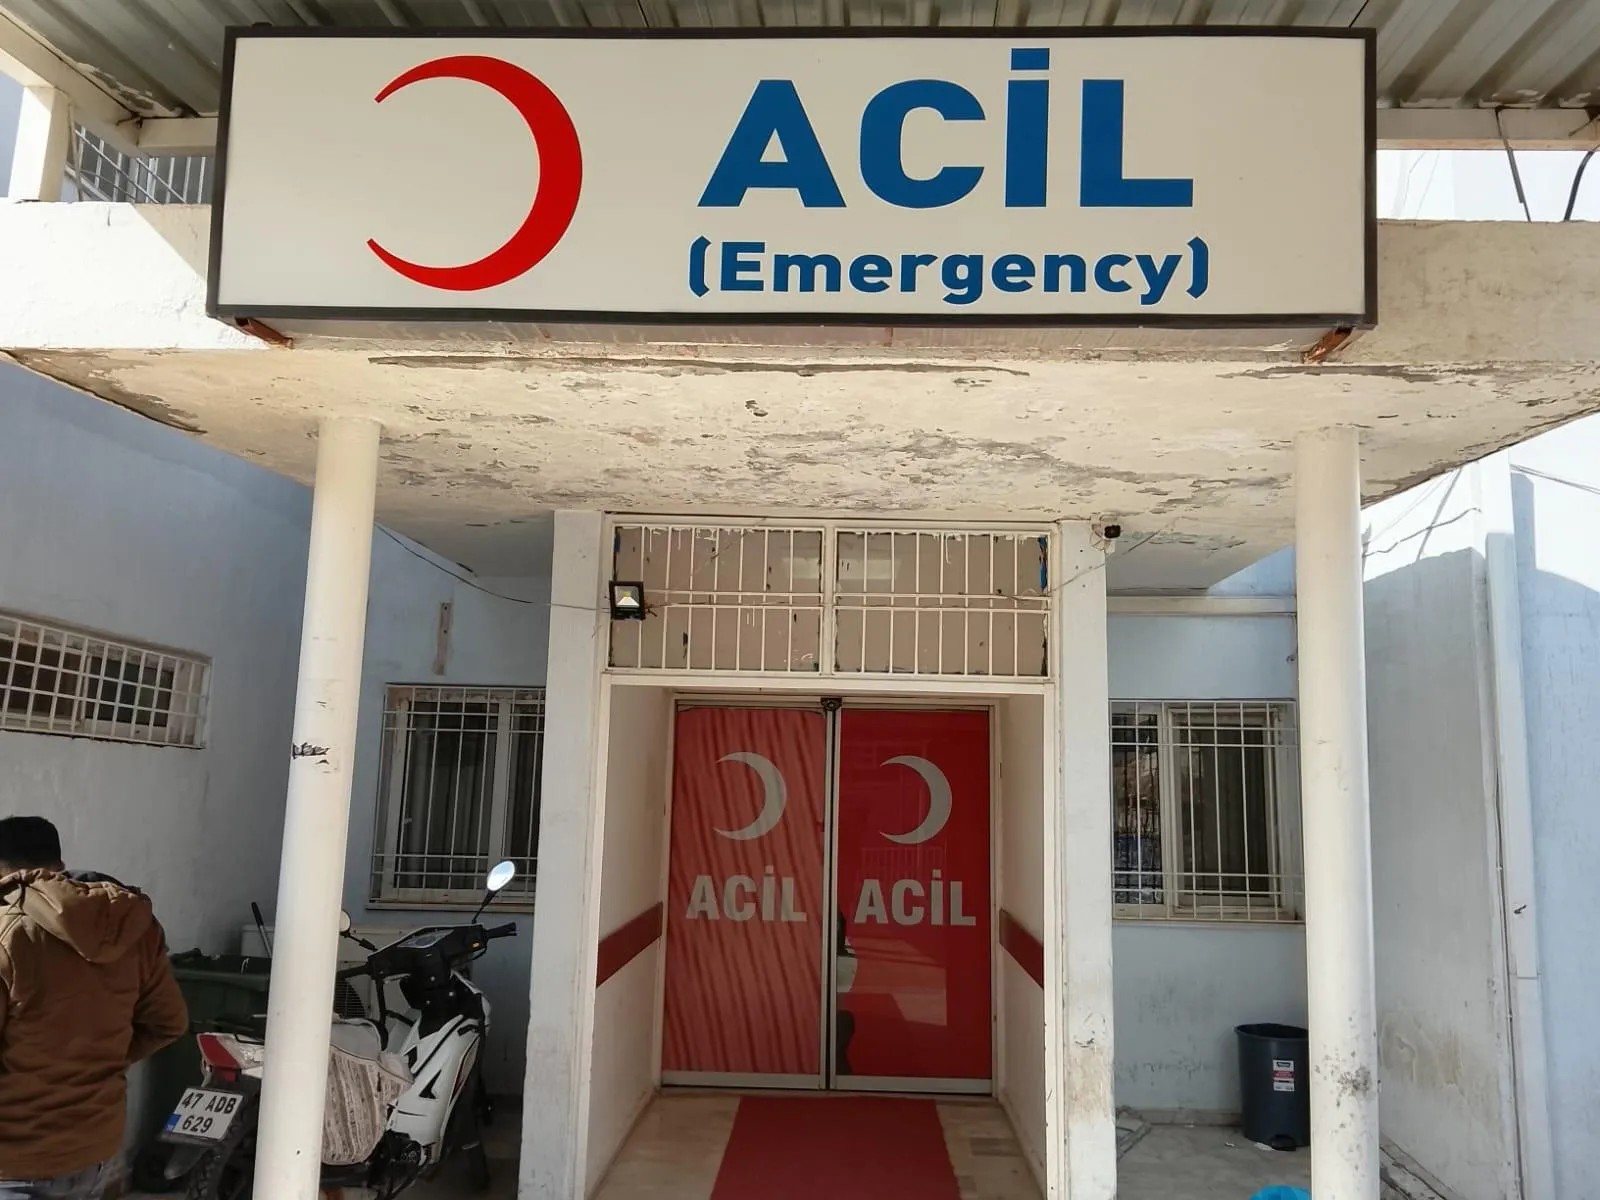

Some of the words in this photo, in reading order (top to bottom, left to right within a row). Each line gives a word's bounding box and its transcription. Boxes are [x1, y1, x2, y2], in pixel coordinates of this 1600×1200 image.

[698, 48, 1193, 208] ACİL
[689, 236, 1208, 305] (Emergency)
[686, 865, 807, 922] ACİL
[854, 869, 976, 926] ACİL
[181, 1092, 204, 1109] 47
[205, 1095, 237, 1114] ADB
[182, 1115, 213, 1133] 629
